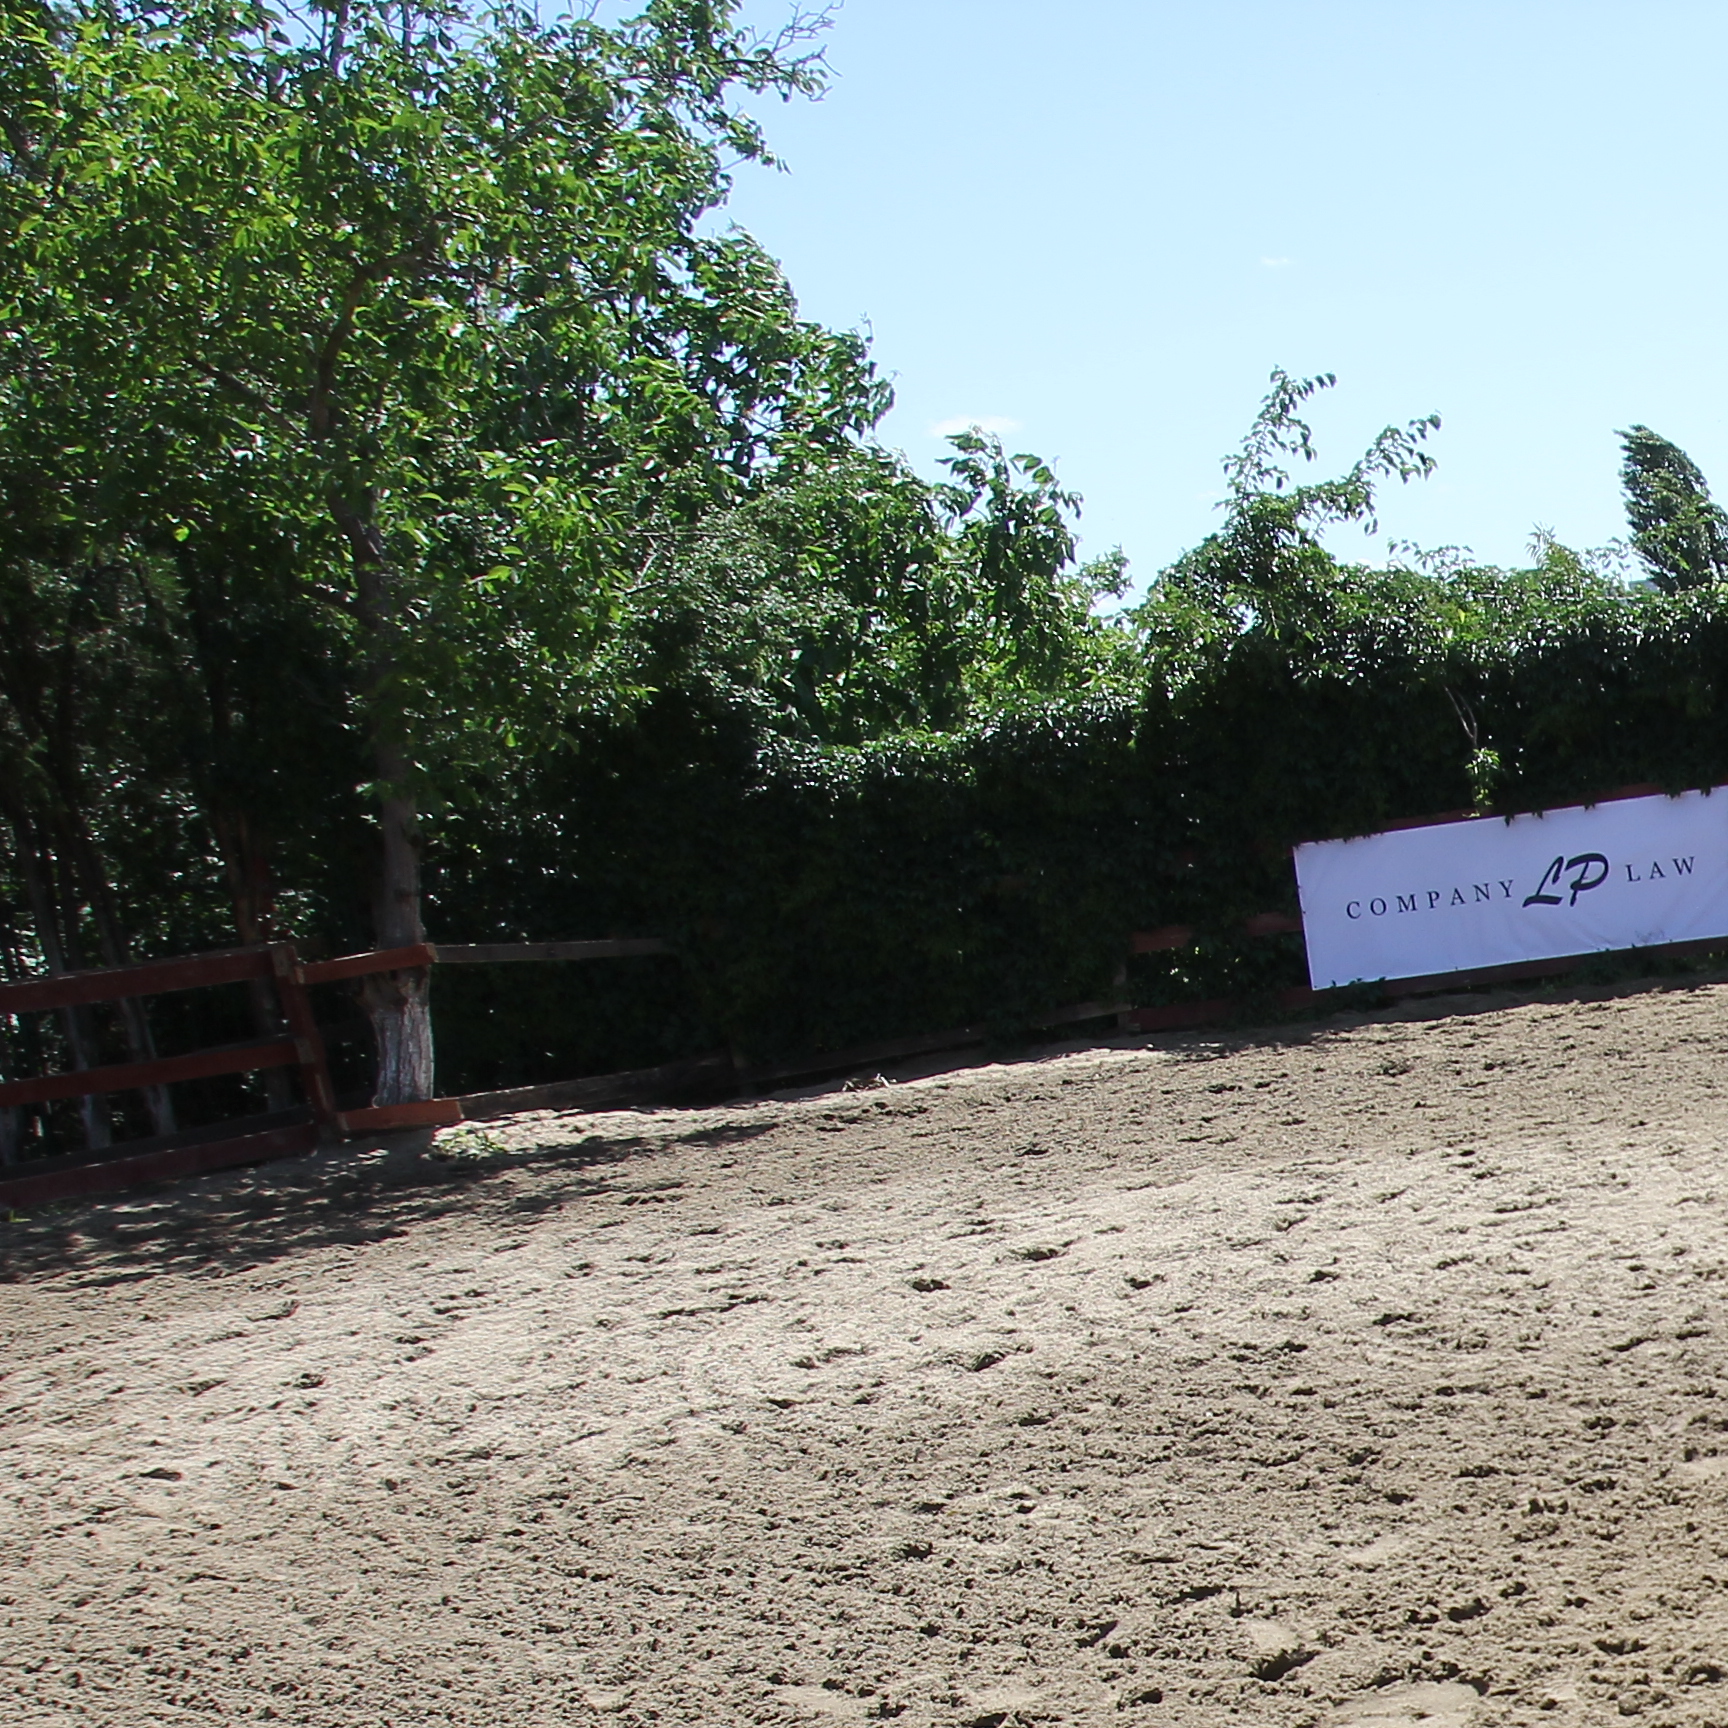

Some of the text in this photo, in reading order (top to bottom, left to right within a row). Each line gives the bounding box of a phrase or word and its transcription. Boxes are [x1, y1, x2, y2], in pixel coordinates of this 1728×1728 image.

[1346, 852, 1698, 919] COMPANY LP LAW
